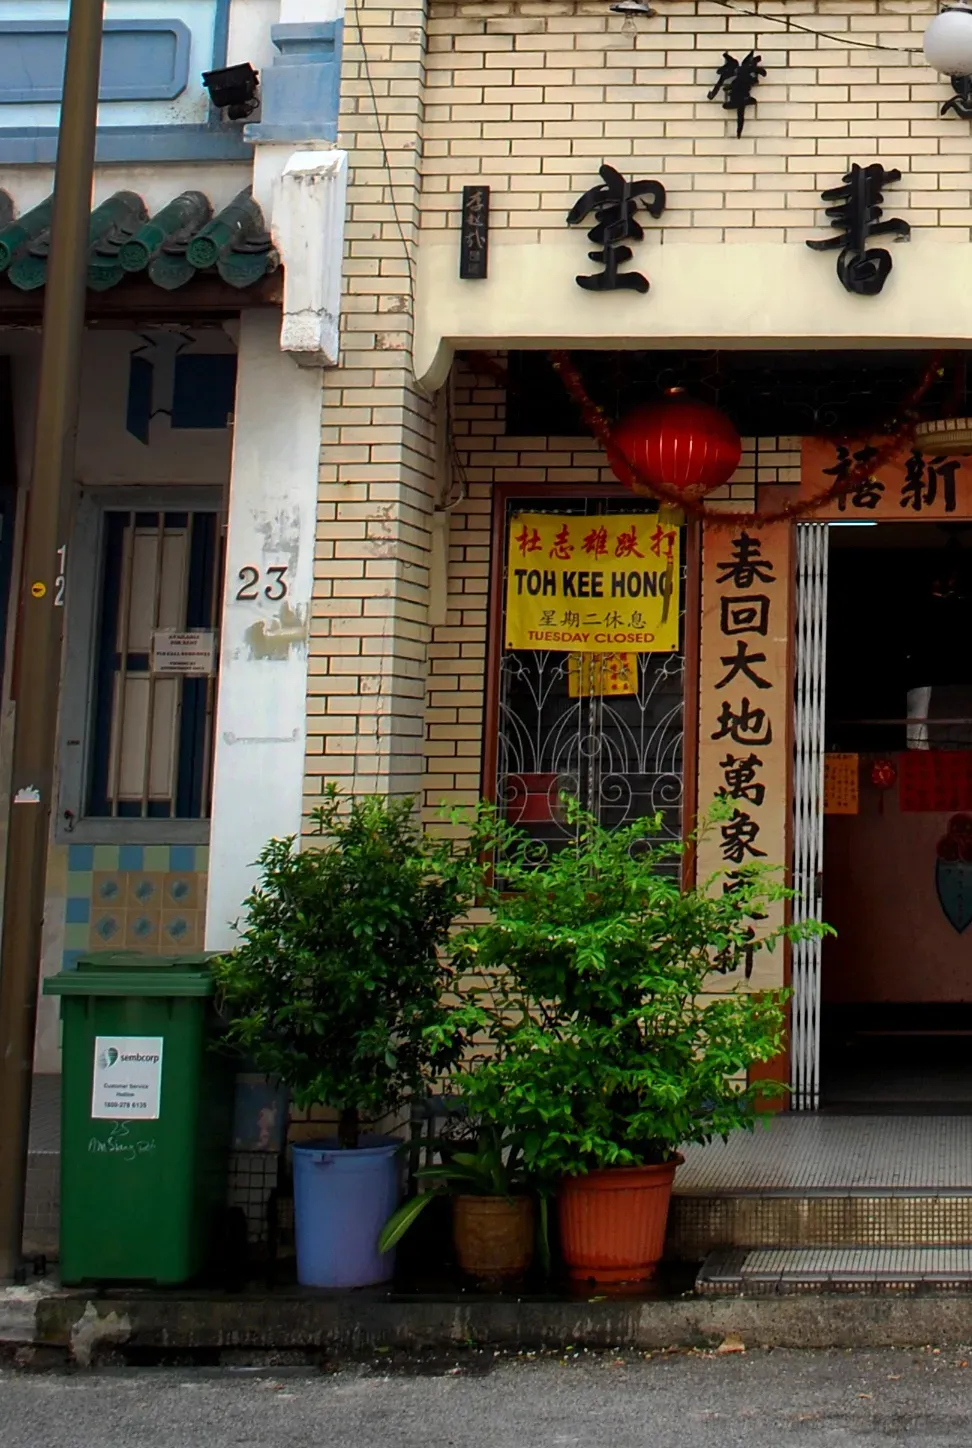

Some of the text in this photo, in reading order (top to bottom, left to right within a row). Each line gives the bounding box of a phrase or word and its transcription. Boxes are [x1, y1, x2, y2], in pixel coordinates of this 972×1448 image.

[514, 523, 677, 562] 杜志雄跌打
[236, 565, 289, 602] 23
[514, 568, 673, 599] TOH KEE HONG
[538, 610, 647, 630] 星期二休息
[527, 630, 655, 644] TUESDAY CLOSED
[120, 1053, 160, 1064] sembcorp
